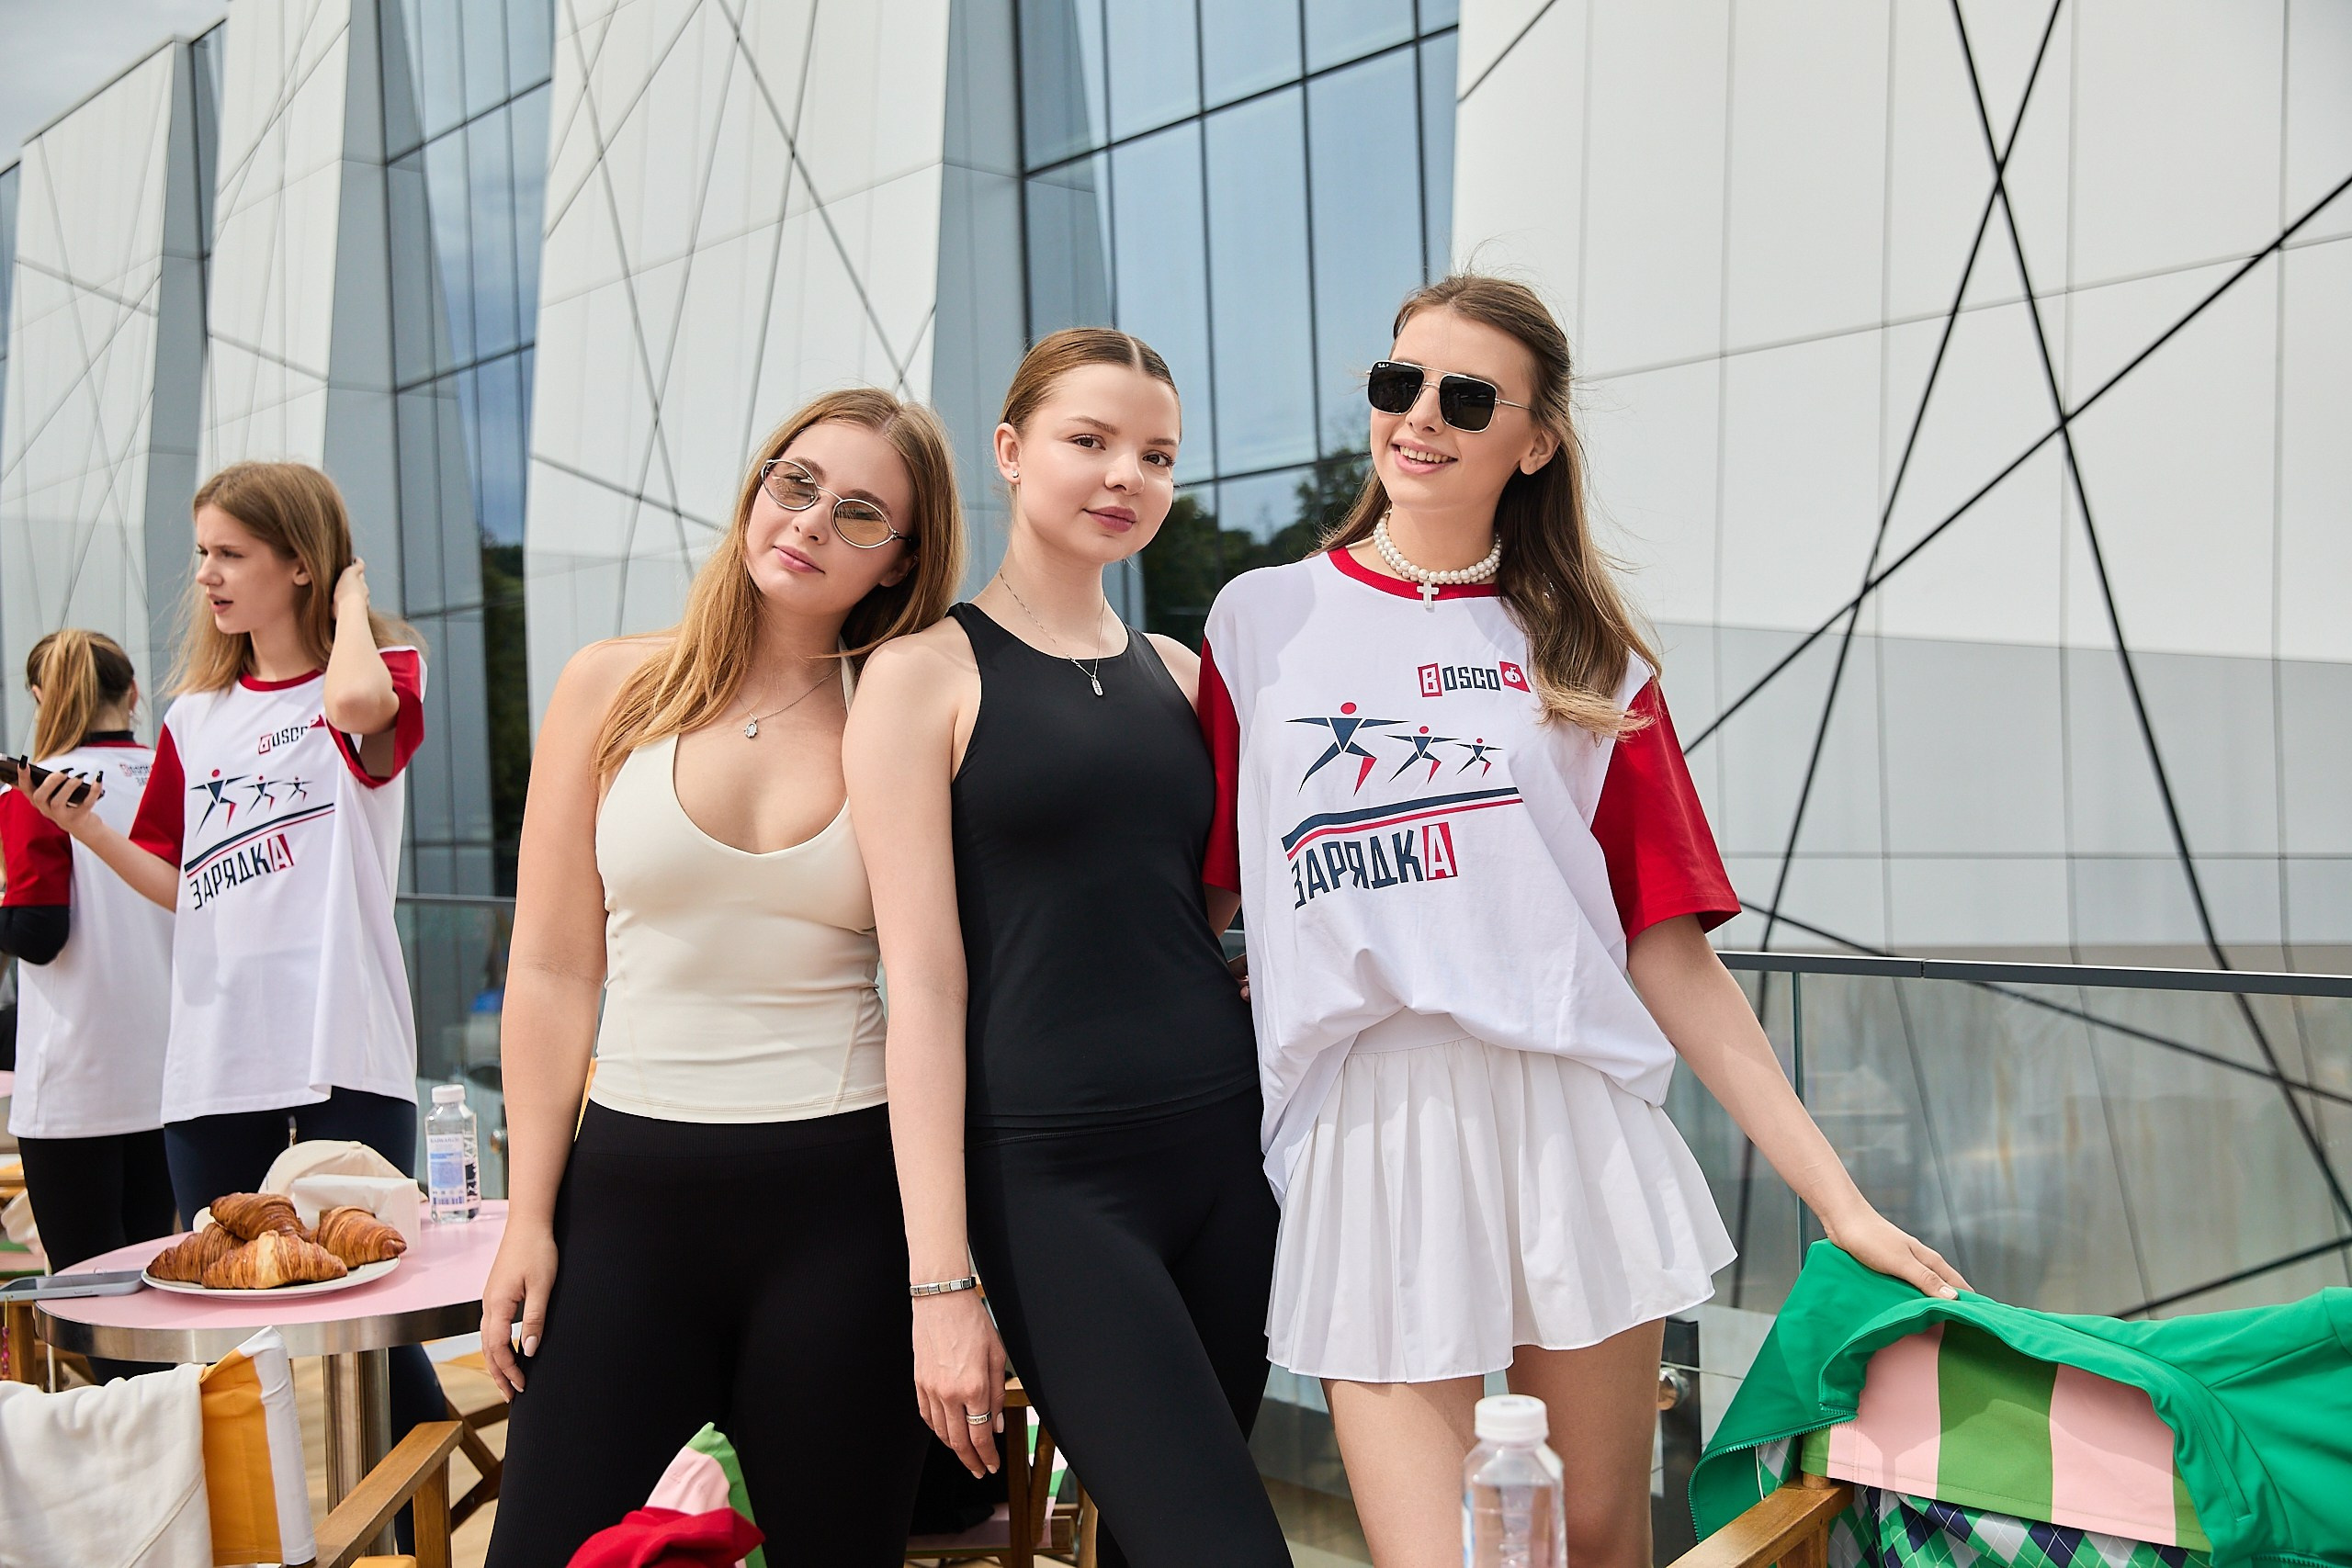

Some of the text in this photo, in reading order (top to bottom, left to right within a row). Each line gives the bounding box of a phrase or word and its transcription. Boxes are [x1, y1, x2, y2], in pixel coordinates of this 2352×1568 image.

[1418, 662, 1501, 698] BOSCO
[189, 833, 294, 910] ЗАРЯДКА
[1291, 821, 1458, 910] ЗАРЯДКА
